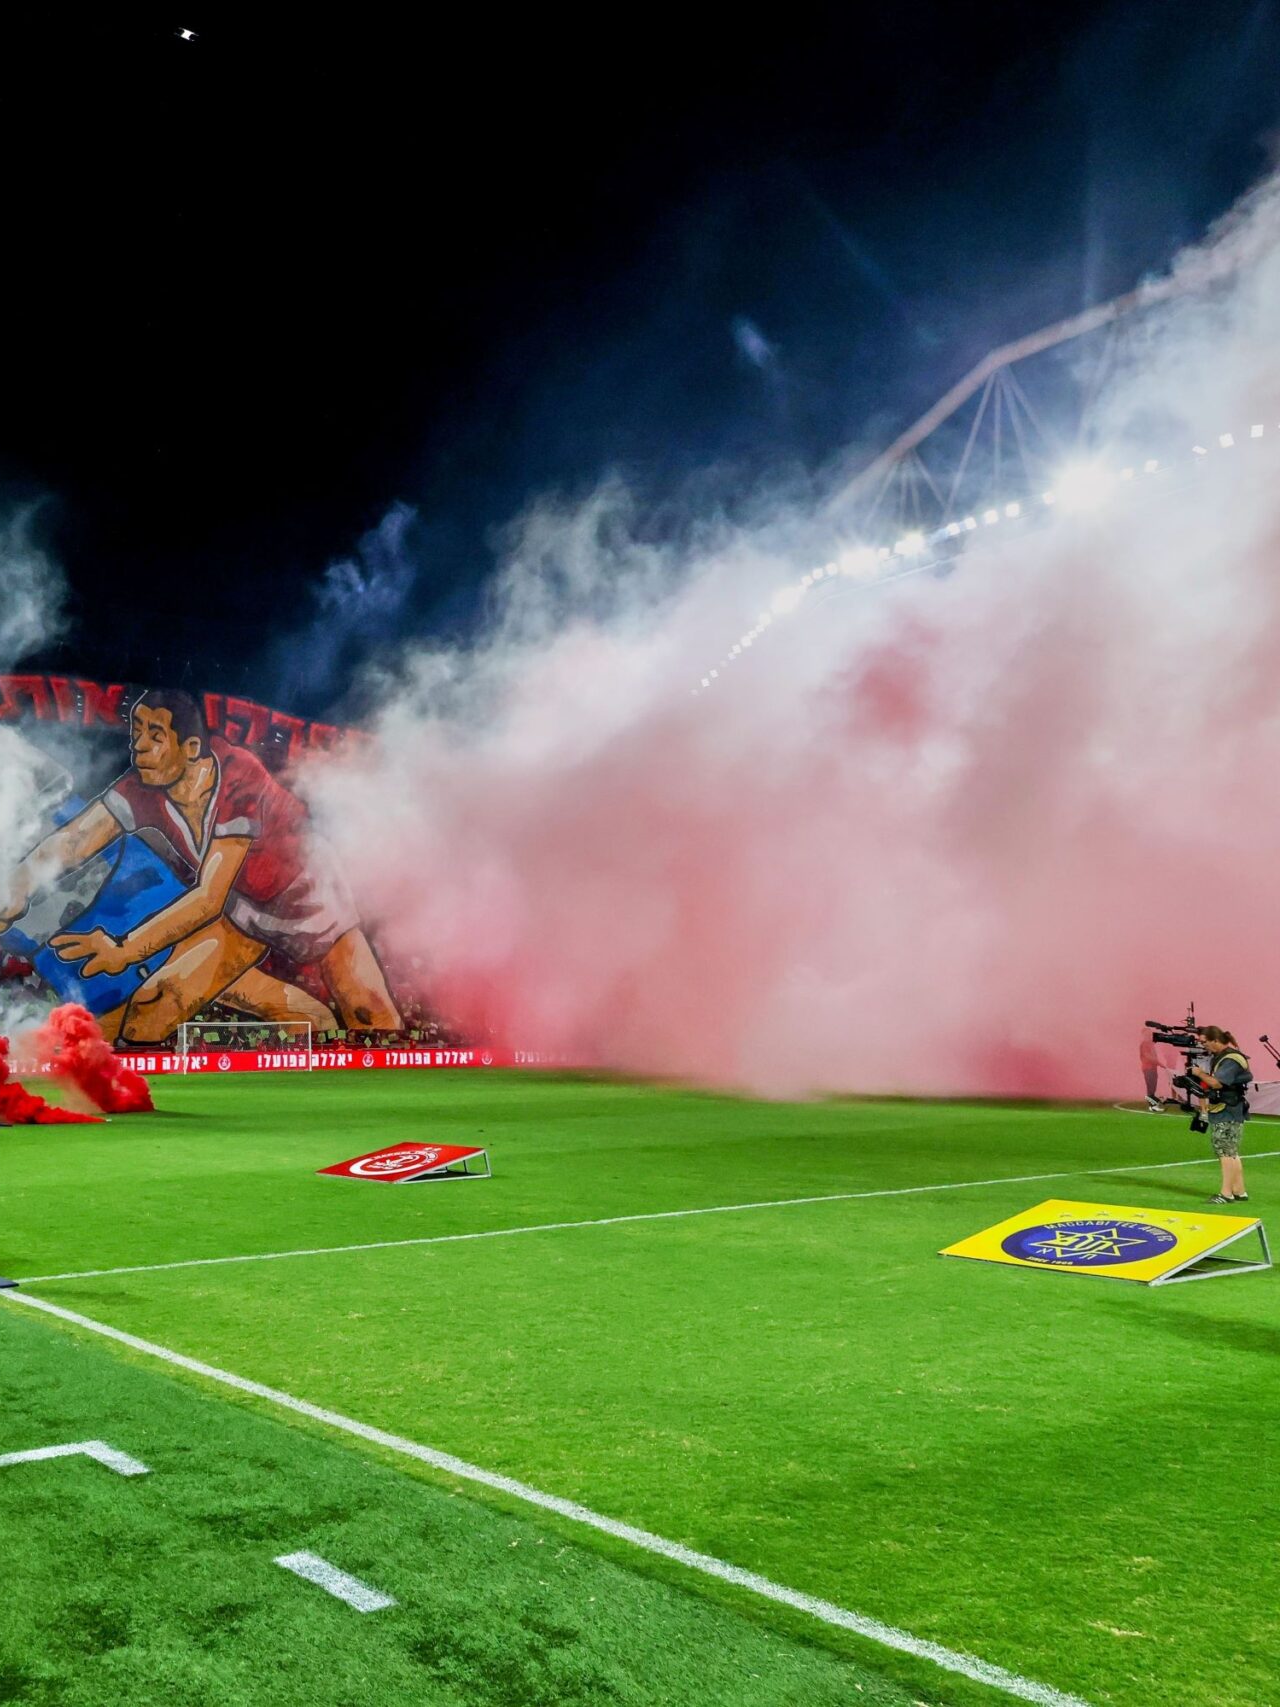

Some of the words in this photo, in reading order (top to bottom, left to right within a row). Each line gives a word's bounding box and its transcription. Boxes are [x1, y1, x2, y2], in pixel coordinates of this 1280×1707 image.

[161, 1055, 208, 1071] יאללה
[257, 1053, 306, 1068] הפועל!
[311, 1052, 353, 1067] יאללה
[385, 1052, 431, 1066] הפועל!
[435, 1051, 474, 1065] יאללה
[1043, 1220, 1111, 1230] MACCABI
[1115, 1220, 1139, 1229] TEL
